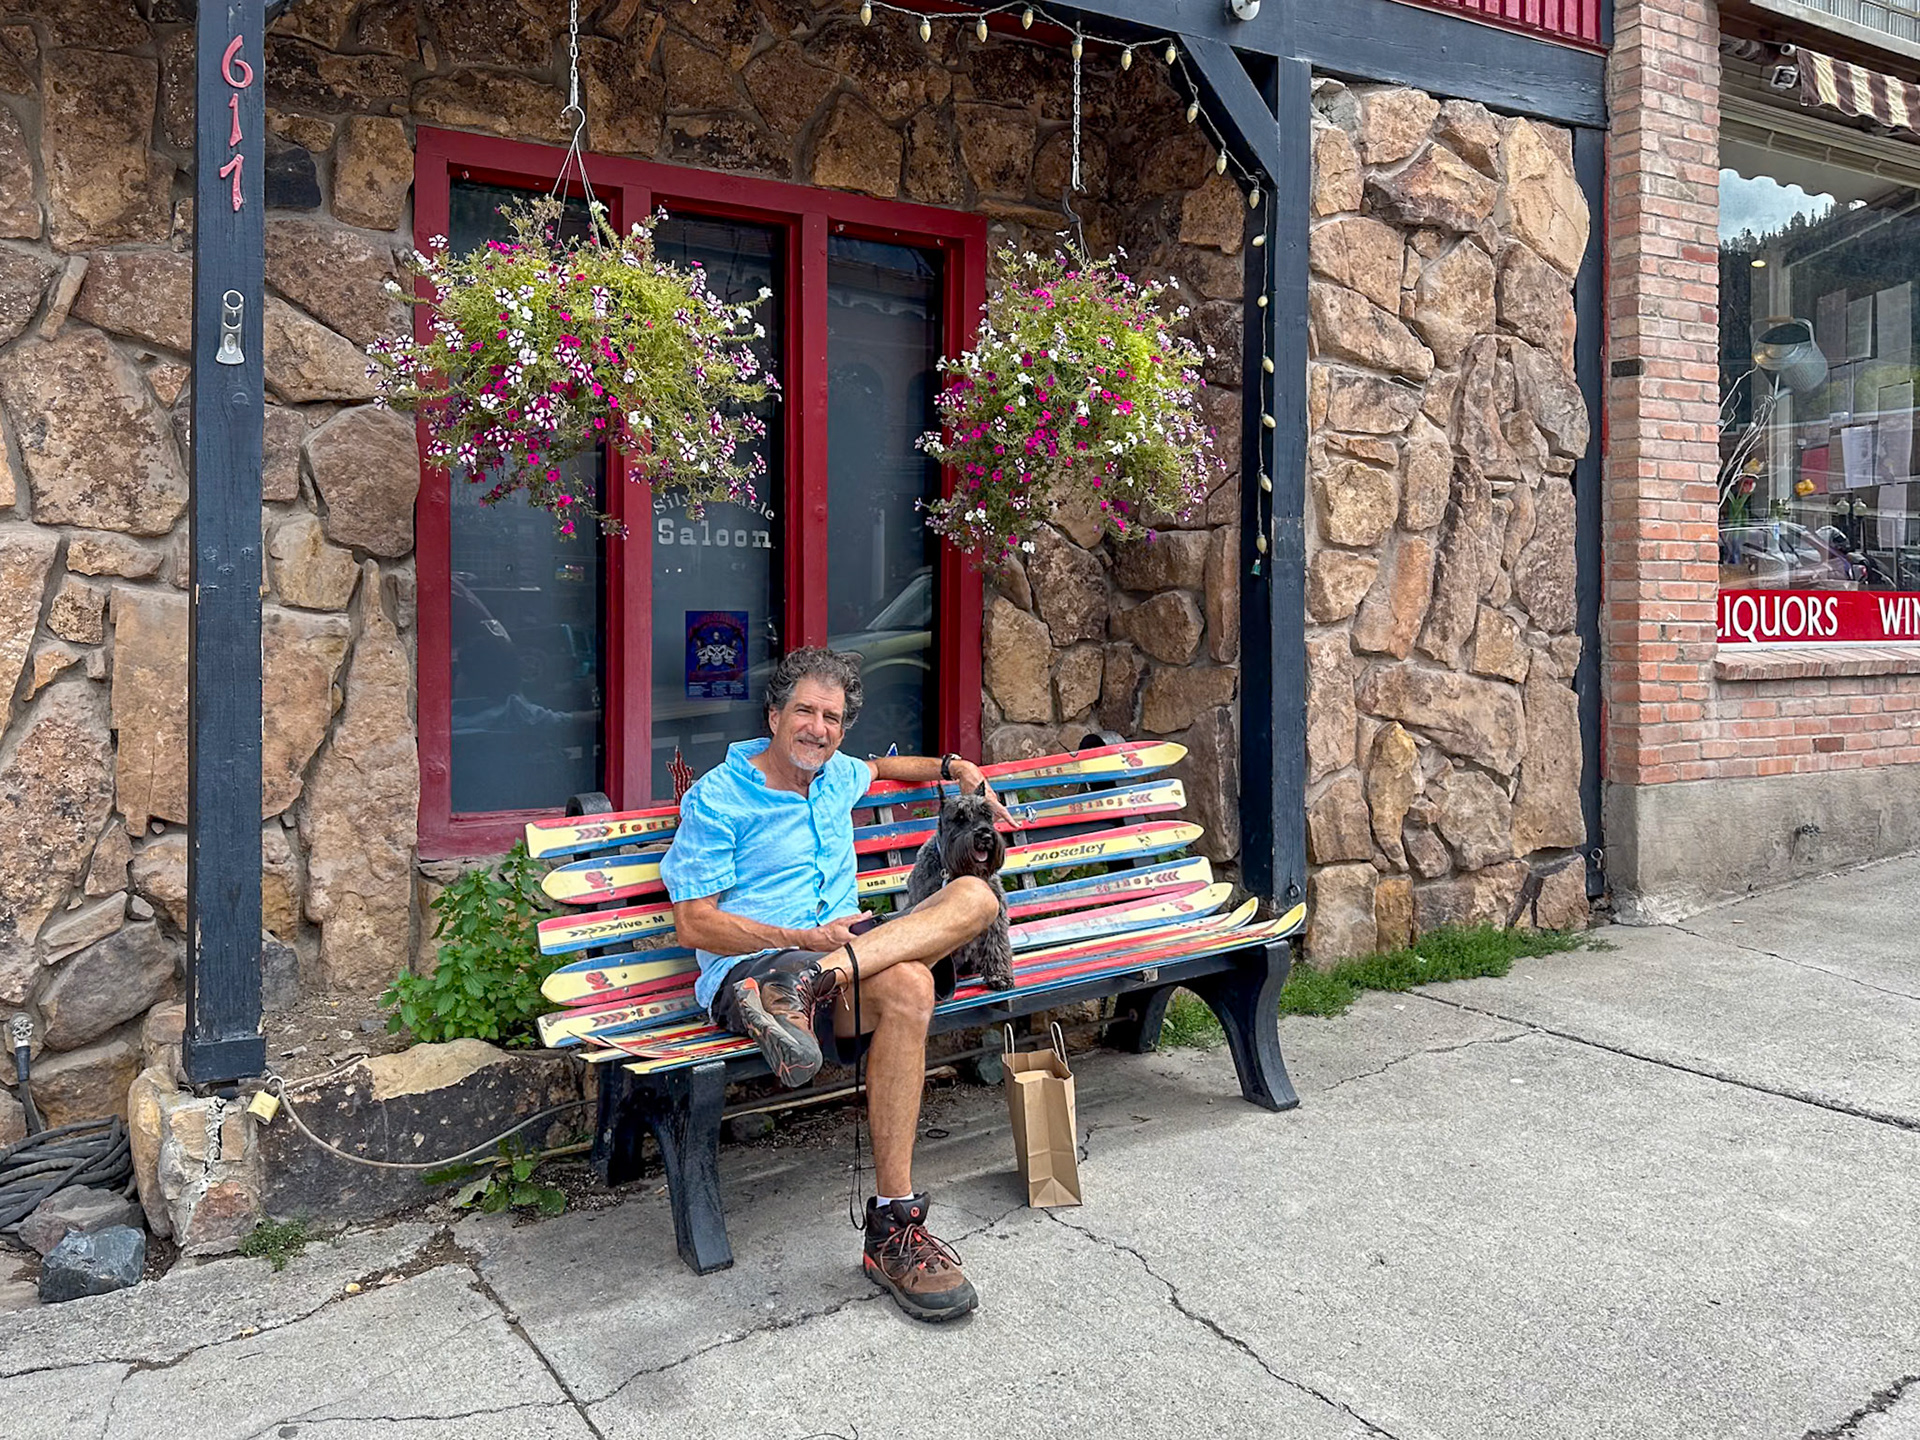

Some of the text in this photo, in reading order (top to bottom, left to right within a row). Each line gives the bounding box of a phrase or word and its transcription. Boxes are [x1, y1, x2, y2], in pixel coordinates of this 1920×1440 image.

[657, 517, 772, 548] Saloon
[1717, 595, 1838, 643] IQUORS
[866, 879, 887, 888] usa
